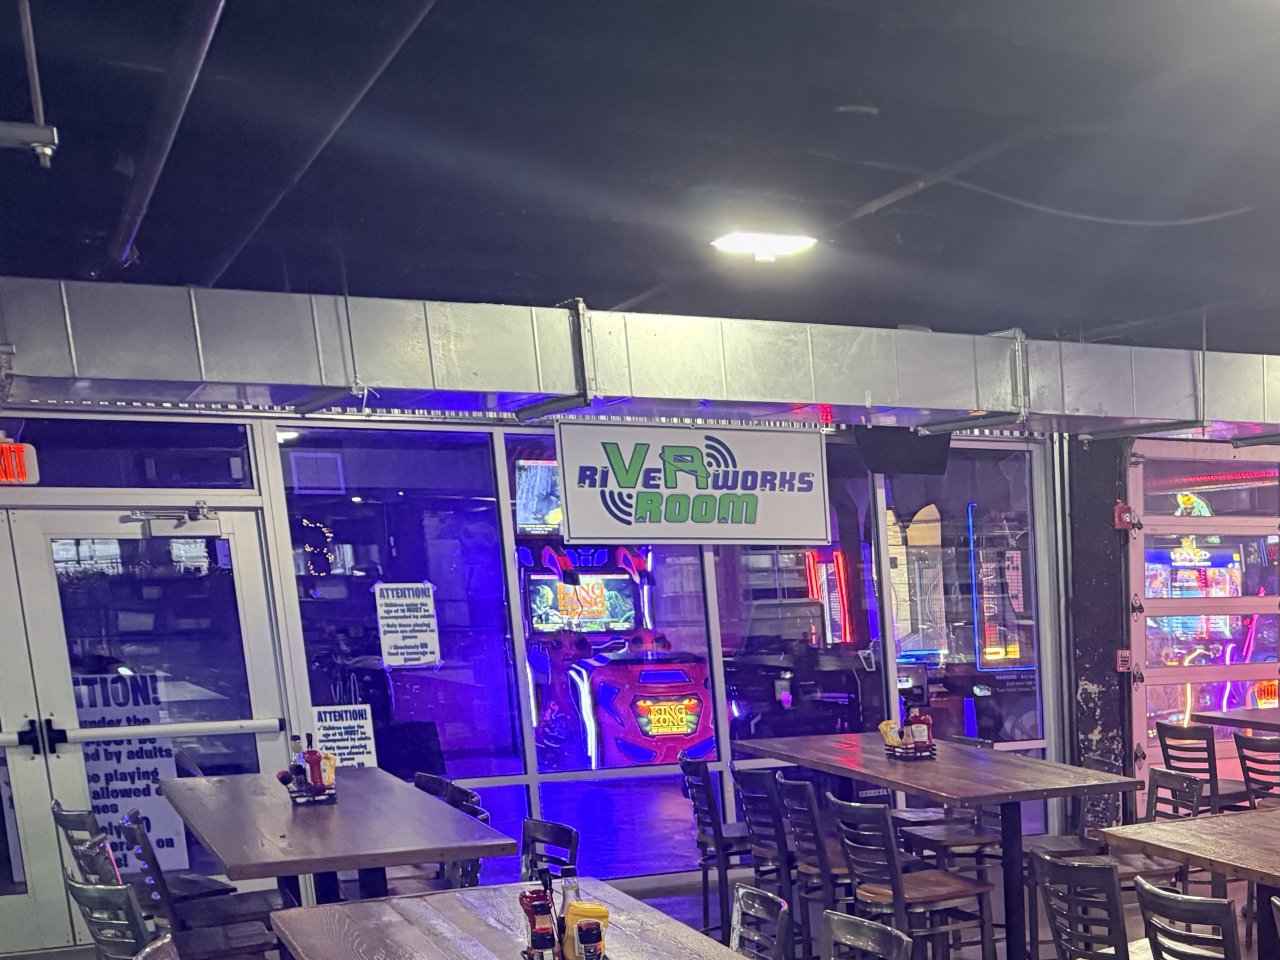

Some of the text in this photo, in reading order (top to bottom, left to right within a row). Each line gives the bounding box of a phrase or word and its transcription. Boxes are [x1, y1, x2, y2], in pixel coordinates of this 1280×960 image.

[0, 443, 27, 482] IT
[634, 491, 758, 524] ROOM
[1170, 551, 1211, 561] HALO
[379, 587, 431, 599] ATTENTION!
[317, 709, 367, 722] ATTENTION!
[650, 705, 685, 717] KING
[651, 715, 687, 727] KONG
[103, 747, 122, 764] by
[127, 746, 173, 760] adults
[104, 767, 160, 785] playing
[92, 784, 151, 800] allowed
[156, 837, 175, 849] on
